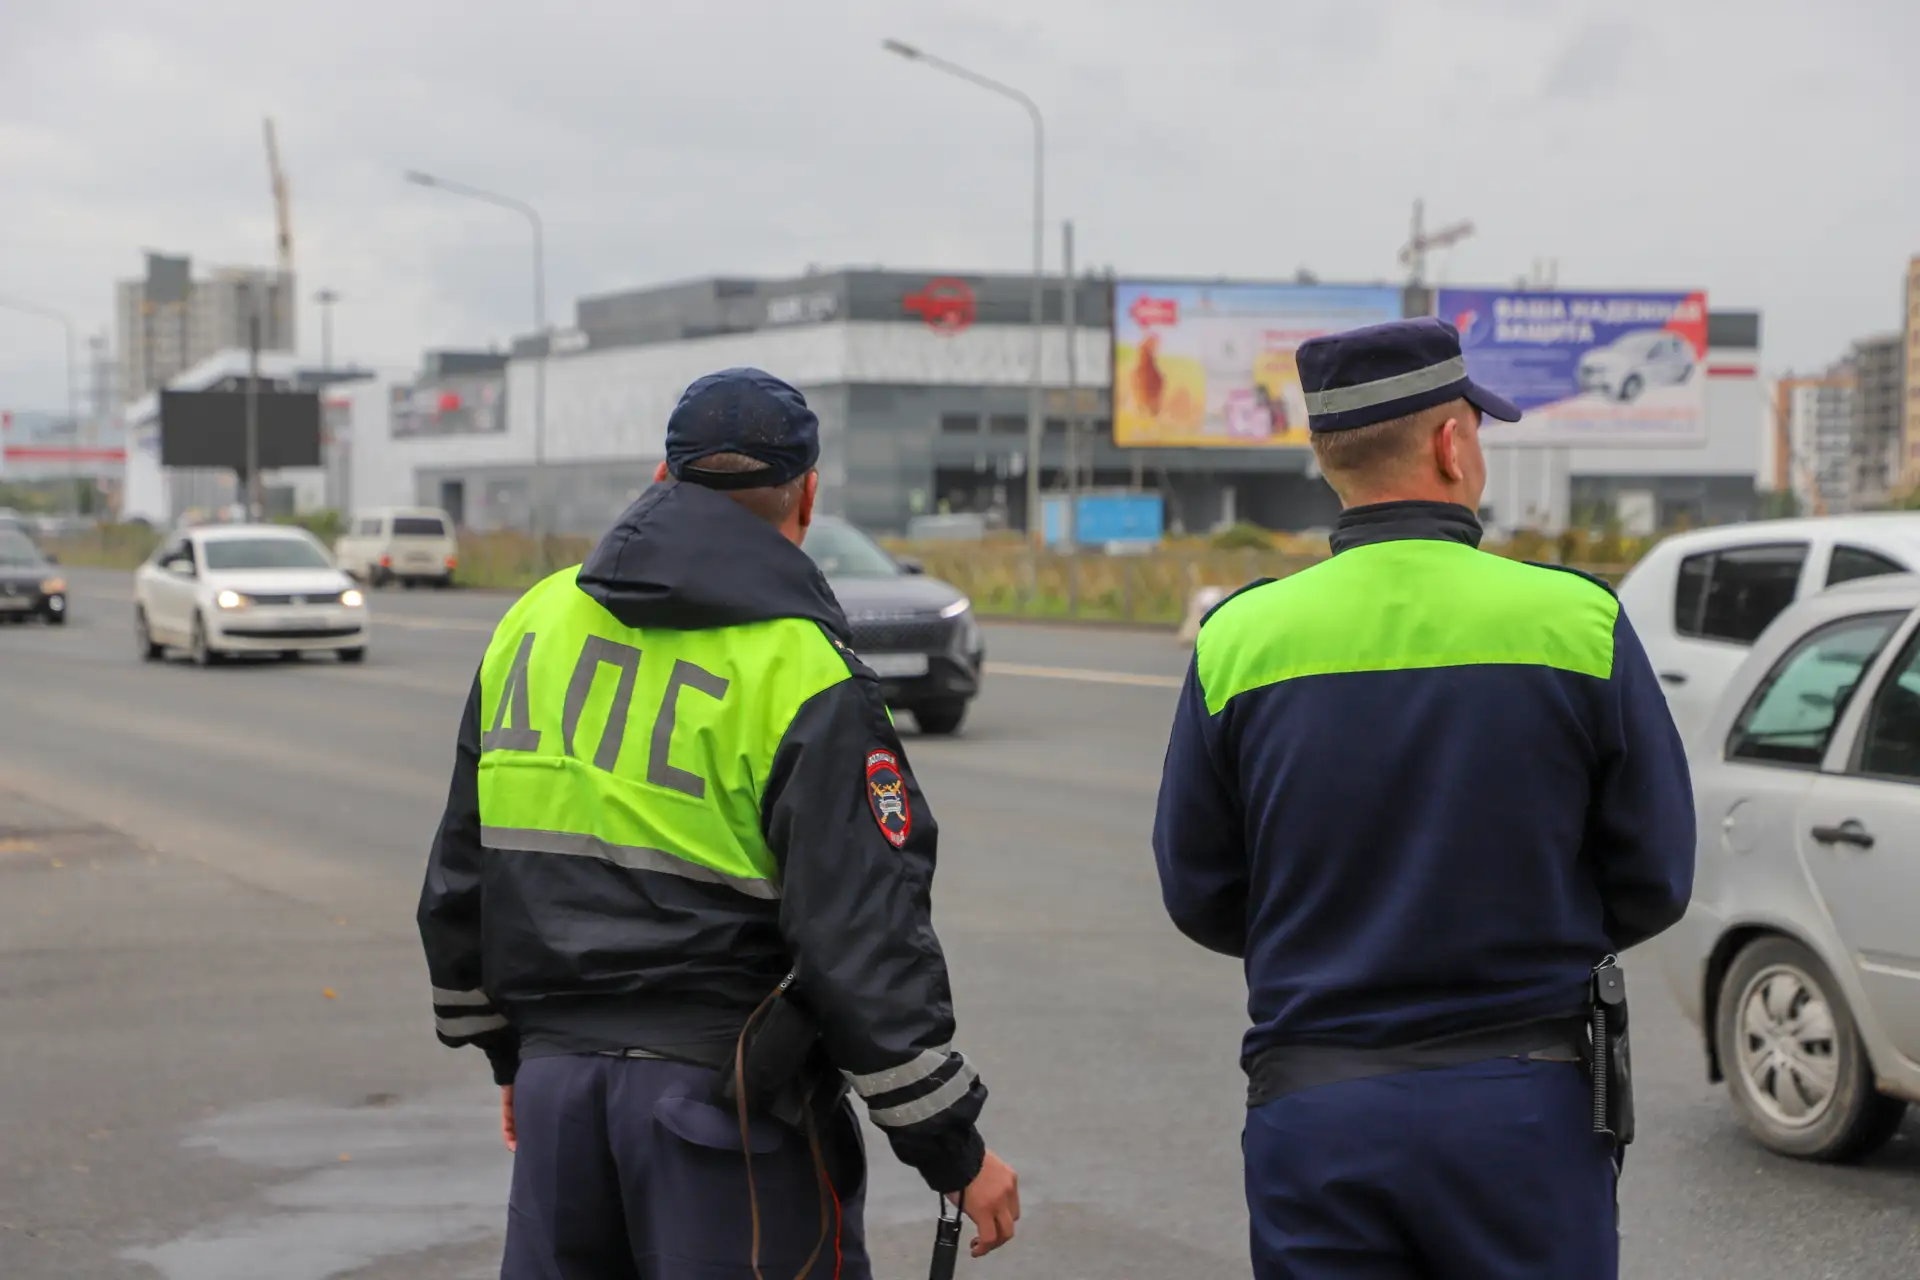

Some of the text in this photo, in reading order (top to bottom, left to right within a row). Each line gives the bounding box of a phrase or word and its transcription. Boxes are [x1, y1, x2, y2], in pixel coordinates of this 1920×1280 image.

[1494, 297, 1566, 318] ВАША
[1495, 322, 1594, 344] ЗАЩИТА
[482, 632, 730, 799] ДПС
